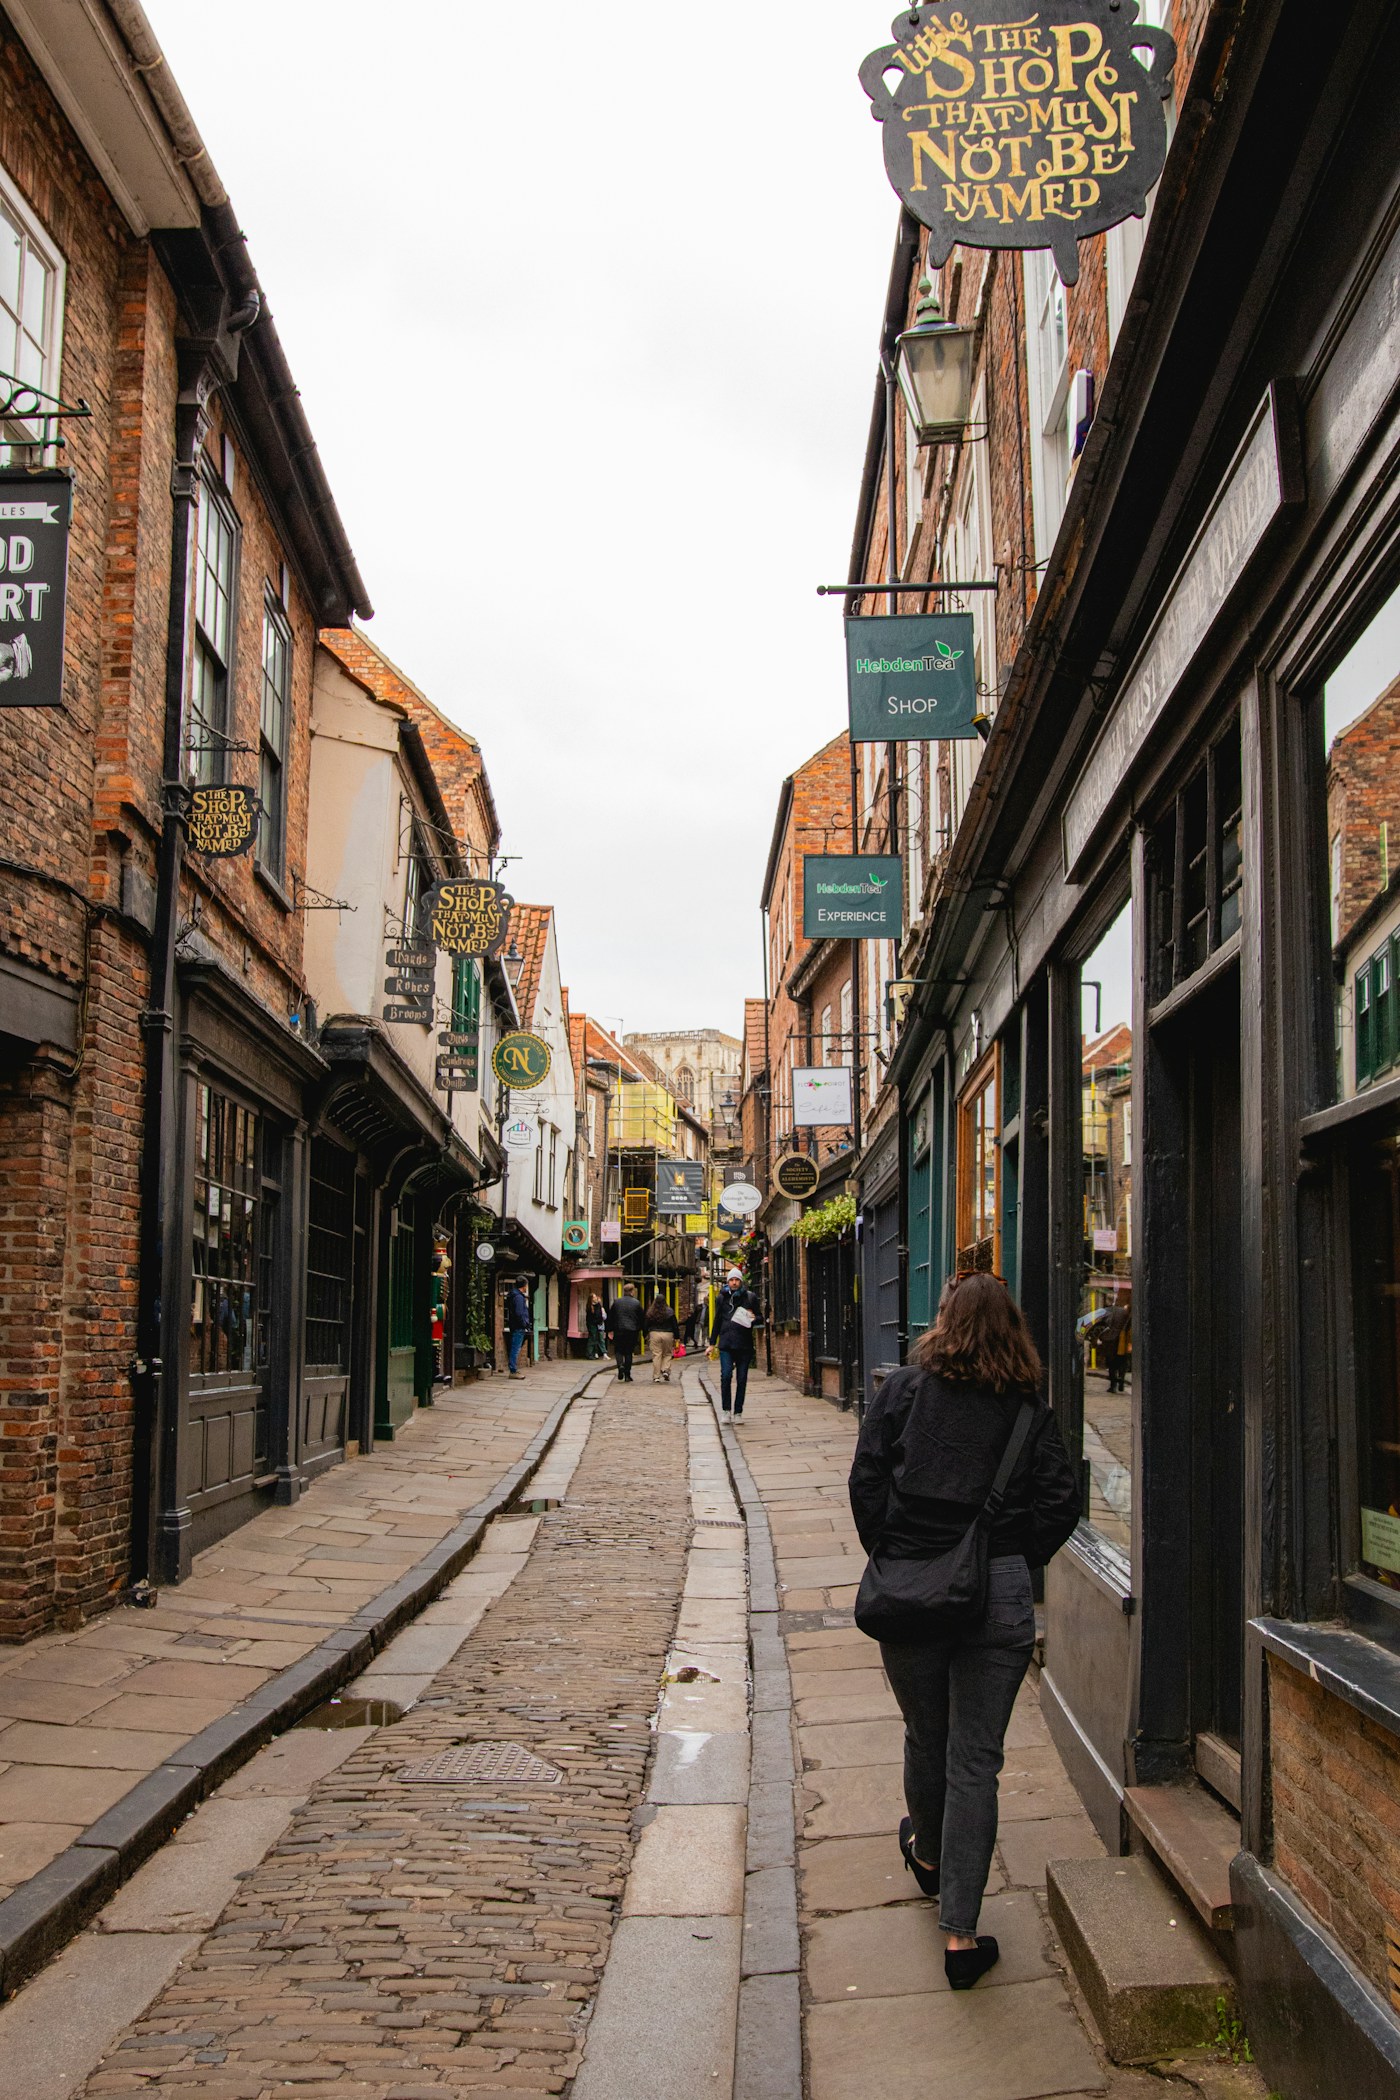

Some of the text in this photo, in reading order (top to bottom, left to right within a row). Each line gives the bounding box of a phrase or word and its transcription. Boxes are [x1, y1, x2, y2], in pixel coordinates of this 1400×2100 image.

[893, 11, 968, 76] little
[973, 12, 1051, 58] THE
[925, 22, 1103, 99] SHOP
[902, 49, 1138, 152] THAT MUST
[907, 129, 1128, 192] NOT BE
[942, 178, 1100, 224] NAMED
[0, 534, 34, 574] D
[1102, 711, 1128, 787] THAT
[1127, 655, 1158, 746] MUST
[1157, 598, 1185, 689] NOT
[1183, 563, 1207, 626] BE
[1207, 446, 1269, 600] NAMED
[857, 656, 955, 673] HebdenTea
[888, 696, 937, 714] SHOP
[192, 790, 245, 814] SHOP
[206, 788, 231, 801] THE
[186, 799, 253, 831] THAT MUST
[188, 822, 249, 841] NOT BE
[196, 839, 242, 853] NAMED
[437, 886, 496, 912] SHOP
[454, 883, 480, 898] THE
[816, 881, 882, 895] HebdenTea
[431, 899, 503, 933] THAT MUST
[818, 908, 887, 922] EXPERIENCE
[431, 919, 499, 940] NOT BE
[440, 938, 489, 954] NAMED
[394, 951, 427, 966] Wands
[395, 978, 430, 993] Robes
[390, 1006, 427, 1021] Brooms
[503, 1047, 539, 1076] N
